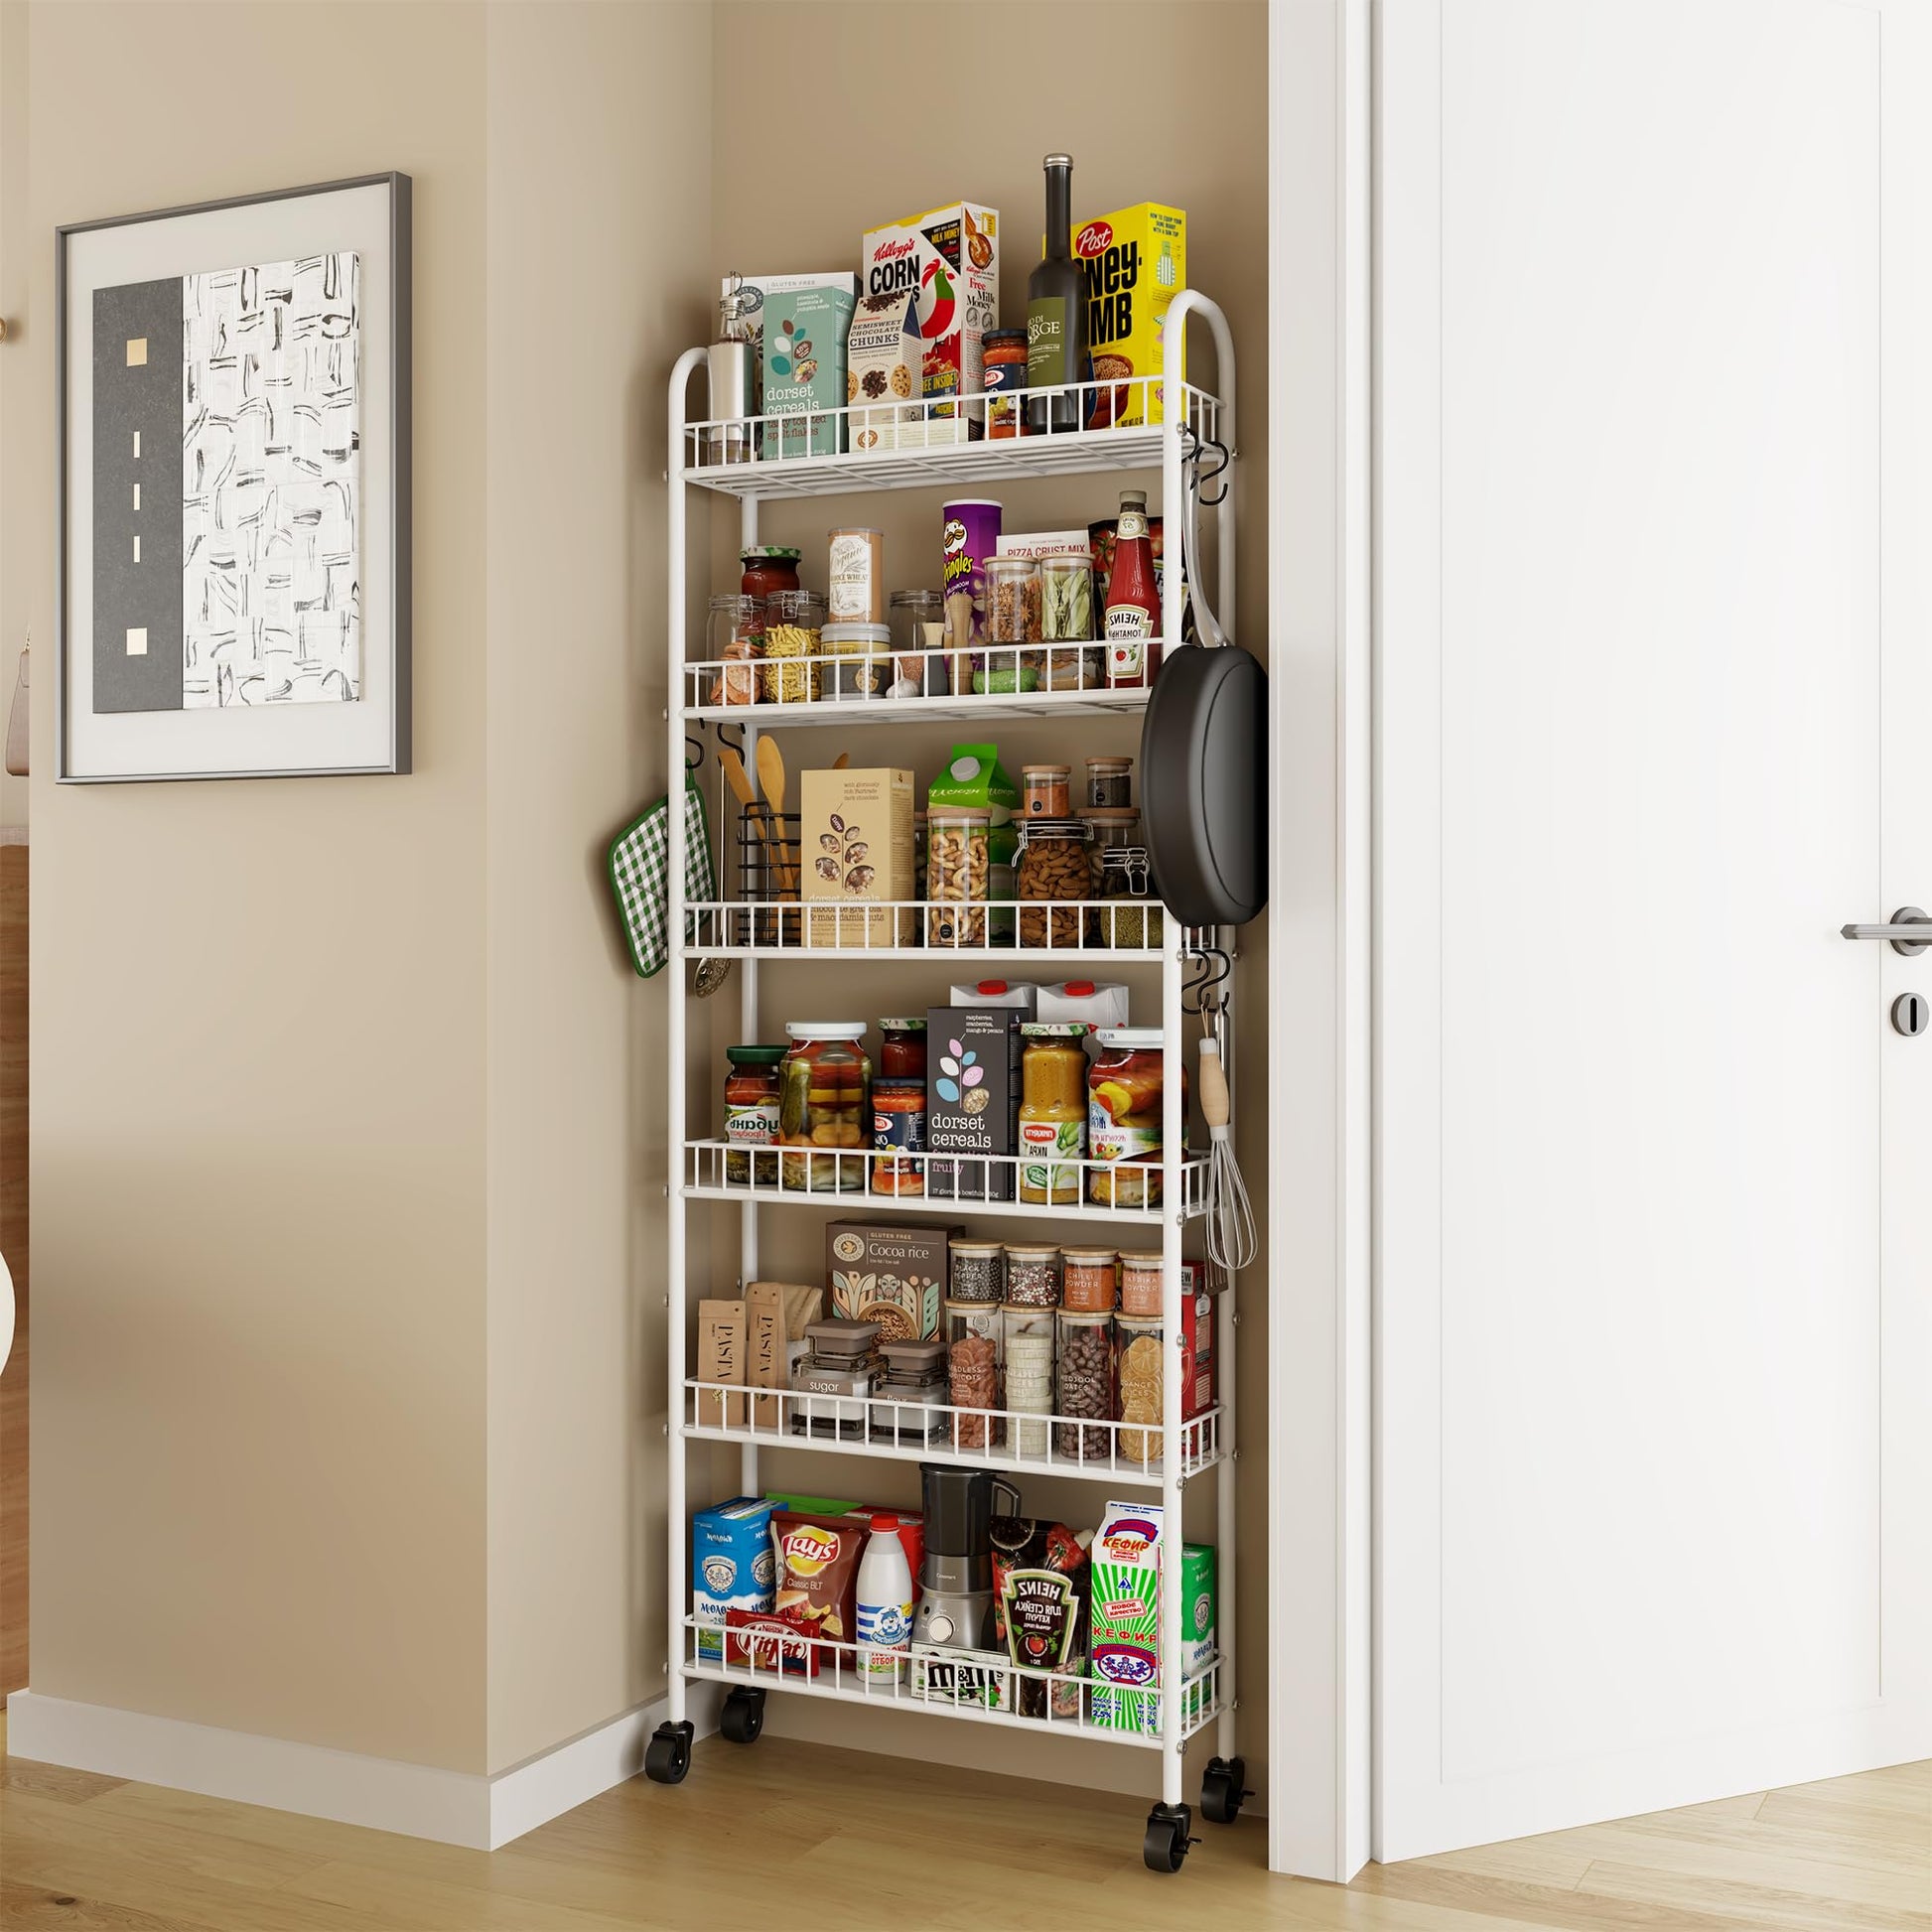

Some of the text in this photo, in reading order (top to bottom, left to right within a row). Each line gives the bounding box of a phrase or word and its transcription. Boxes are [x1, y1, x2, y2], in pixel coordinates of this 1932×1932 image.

[1078, 226, 1111, 255] Post
[874, 237, 915, 262] Kellogg's
[870, 254, 920, 296] CORN
[969, 277, 986, 291] Free
[966, 294, 992, 312] Money
[977, 290, 996, 305] Milk
[850, 326, 901, 338] CHOCOLATE
[852, 319, 902, 332] SEMISWEET
[850, 333, 899, 347] CHUNKS
[766, 383, 814, 401] dorset
[922, 377, 932, 392] REE
[766, 399, 820, 415] cereals
[1008, 544, 1085, 557] PIZZA CRUST MIX
[931, 1113, 985, 1131] dorset
[931, 1133, 992, 1149] cereals
[932, 1161, 964, 1175] fruiy
[869, 1242, 929, 1259] Cocoa rice
[717, 1325, 734, 1378] PASTA
[759, 1317, 773, 1372] PASTA
[809, 1381, 840, 1394] sugar
[785, 1536, 837, 1561] Lay's
[1102, 1537, 1151, 1552] КЕФИР
[787, 1578, 824, 1590] Classic BLT
[1093, 1626, 1157, 1644] КЕФИР
[871, 1655, 907, 1665] ОТБОР
[1092, 1710, 1112, 1719] 2,5%
